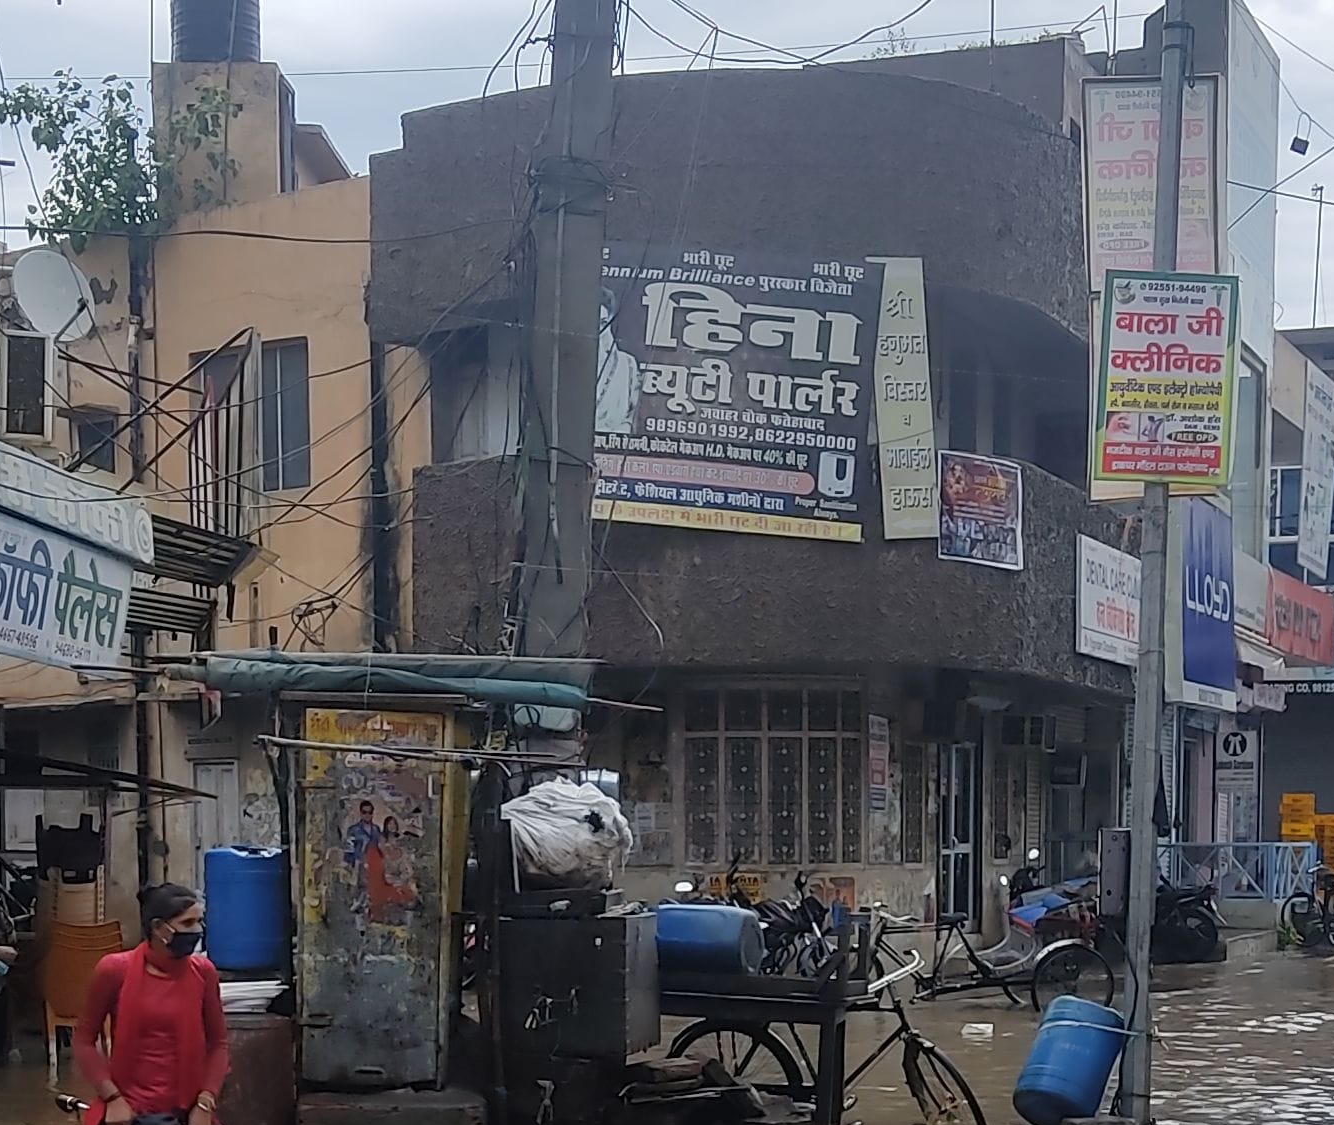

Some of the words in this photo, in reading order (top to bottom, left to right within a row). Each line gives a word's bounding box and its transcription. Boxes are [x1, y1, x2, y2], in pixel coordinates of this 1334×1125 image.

[668, 266, 756, 288] Brilliance
[682, 251, 711, 268] भारी
[713, 252, 736, 272] छूट
[813, 261, 841, 279] भारी
[843, 264, 865, 283] छूट
[642, 281, 863, 365] हिना
[1115, 311, 1180, 336] बाला
[1185, 306, 1225, 337] जी
[1110, 341, 1225, 374] क्लीनिक
[746, 369, 861, 418] पार्लर
[1170, 431, 1194, 441] FREE
[1195, 431, 1216, 441] OPD
[763, 448, 784, 465] 40%
[55, 549, 123, 649] पैलेस
[1185, 565, 1231, 622] LLOYD
